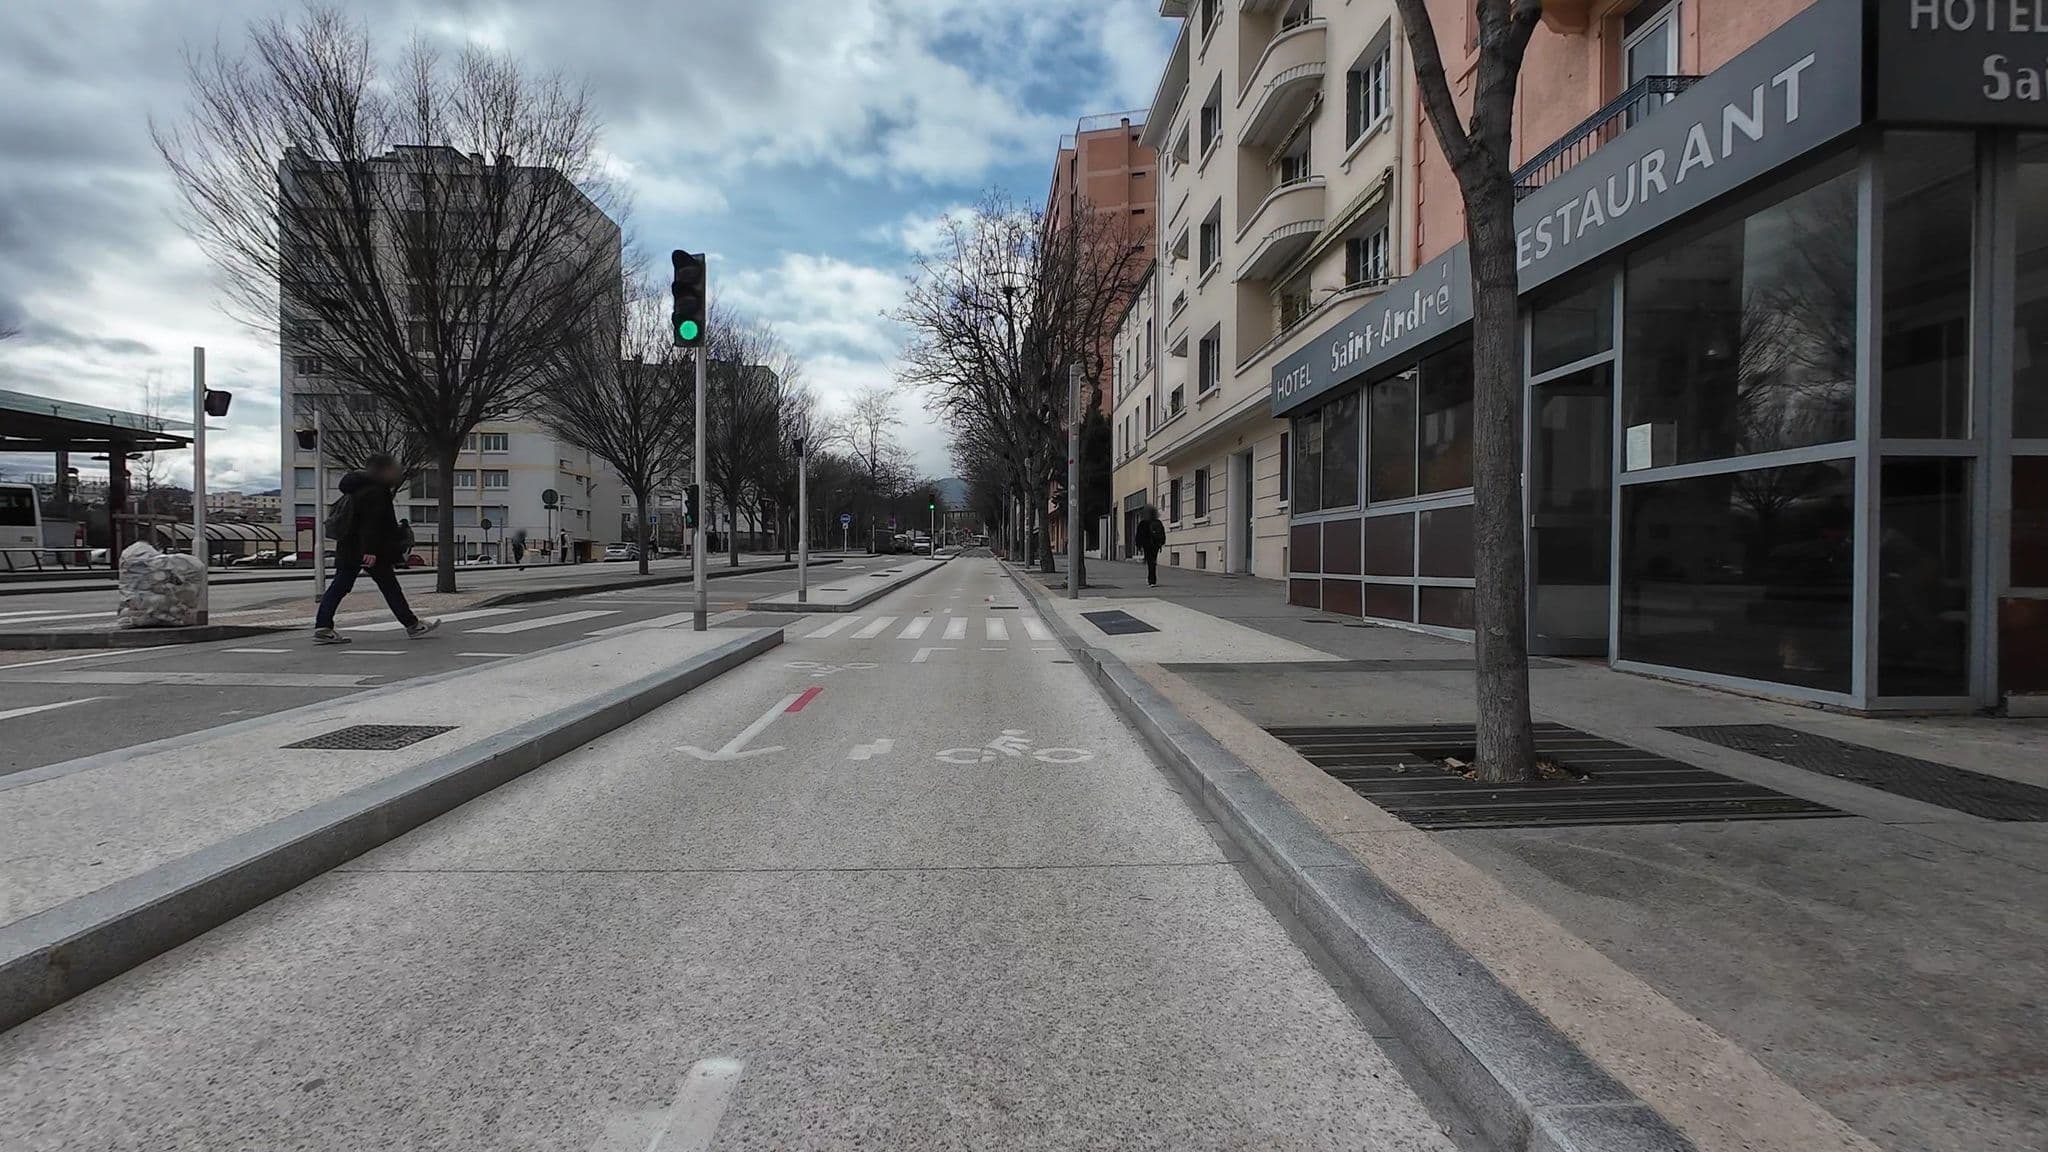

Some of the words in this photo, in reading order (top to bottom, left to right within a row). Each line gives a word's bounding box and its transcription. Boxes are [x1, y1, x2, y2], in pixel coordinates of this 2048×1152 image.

[1910, 0, 2048, 32] HOTEL
[1982, 54, 2048, 101] Sa
[1277, 363, 1312, 400] HOTEL
[1330, 263, 1449, 372] Saint-André
[1516, 52, 1815, 272] ESTAURANT
